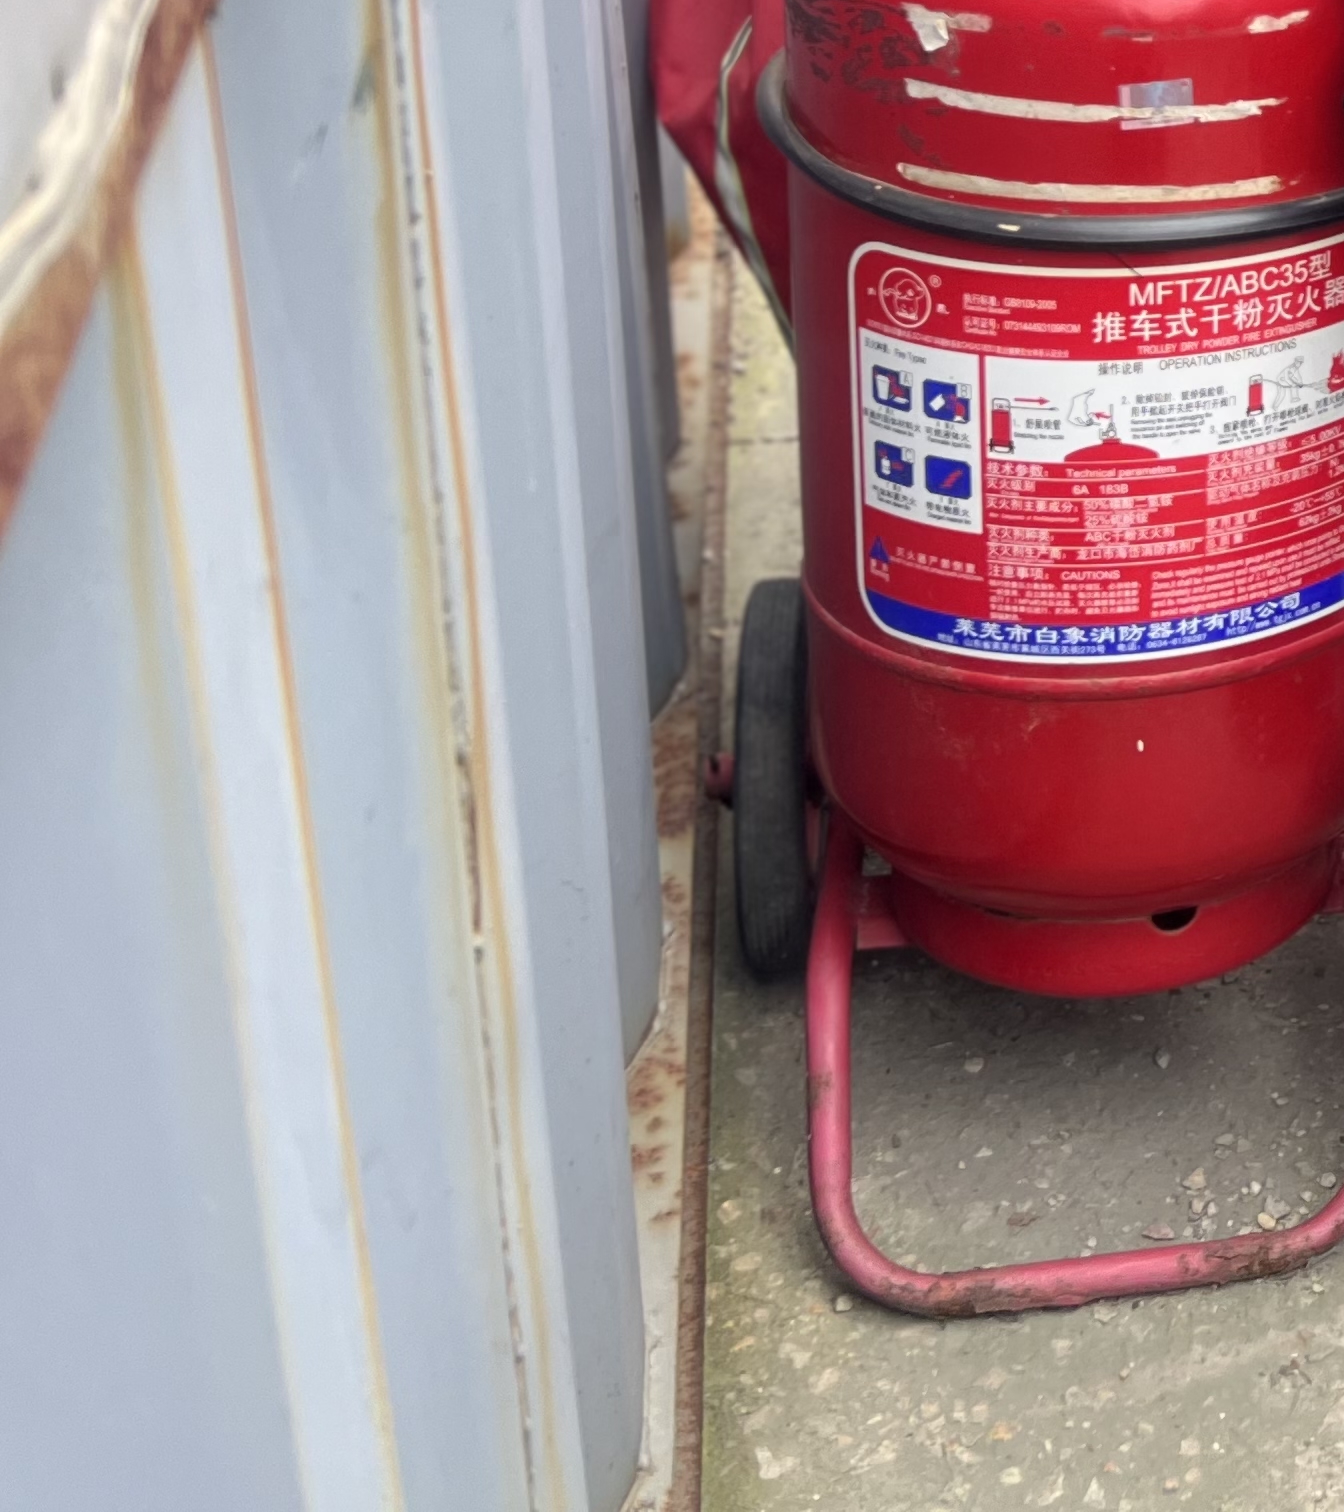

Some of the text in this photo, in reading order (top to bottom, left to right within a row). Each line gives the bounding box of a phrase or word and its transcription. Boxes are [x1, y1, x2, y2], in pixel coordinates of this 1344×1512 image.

[1128, 250, 1332, 306] MFTZ/ABC35型
[1137, 317, 1318, 355] TROLLEY DRY POWDER FIRE EXTINGUISHER
[1098, 338, 1297, 376] 操作说明 OPERATION INSTRUCTIONS
[960, 384, 968, 398] B
[986, 462, 1177, 480] 技术参数： Technical parameters
[986, 479, 1036, 492] 灭火级别
[1071, 484, 1090, 496] 6A
[986, 496, 1079, 513] 灭火剂主要成分：
[1085, 525, 1175, 542] ABC干粉灭火剂
[988, 565, 1049, 580] 注意事项：
[1061, 570, 1120, 580] CAUTIONS
[953, 592, 1300, 644] 莱芜市白象消防器材有限公司
